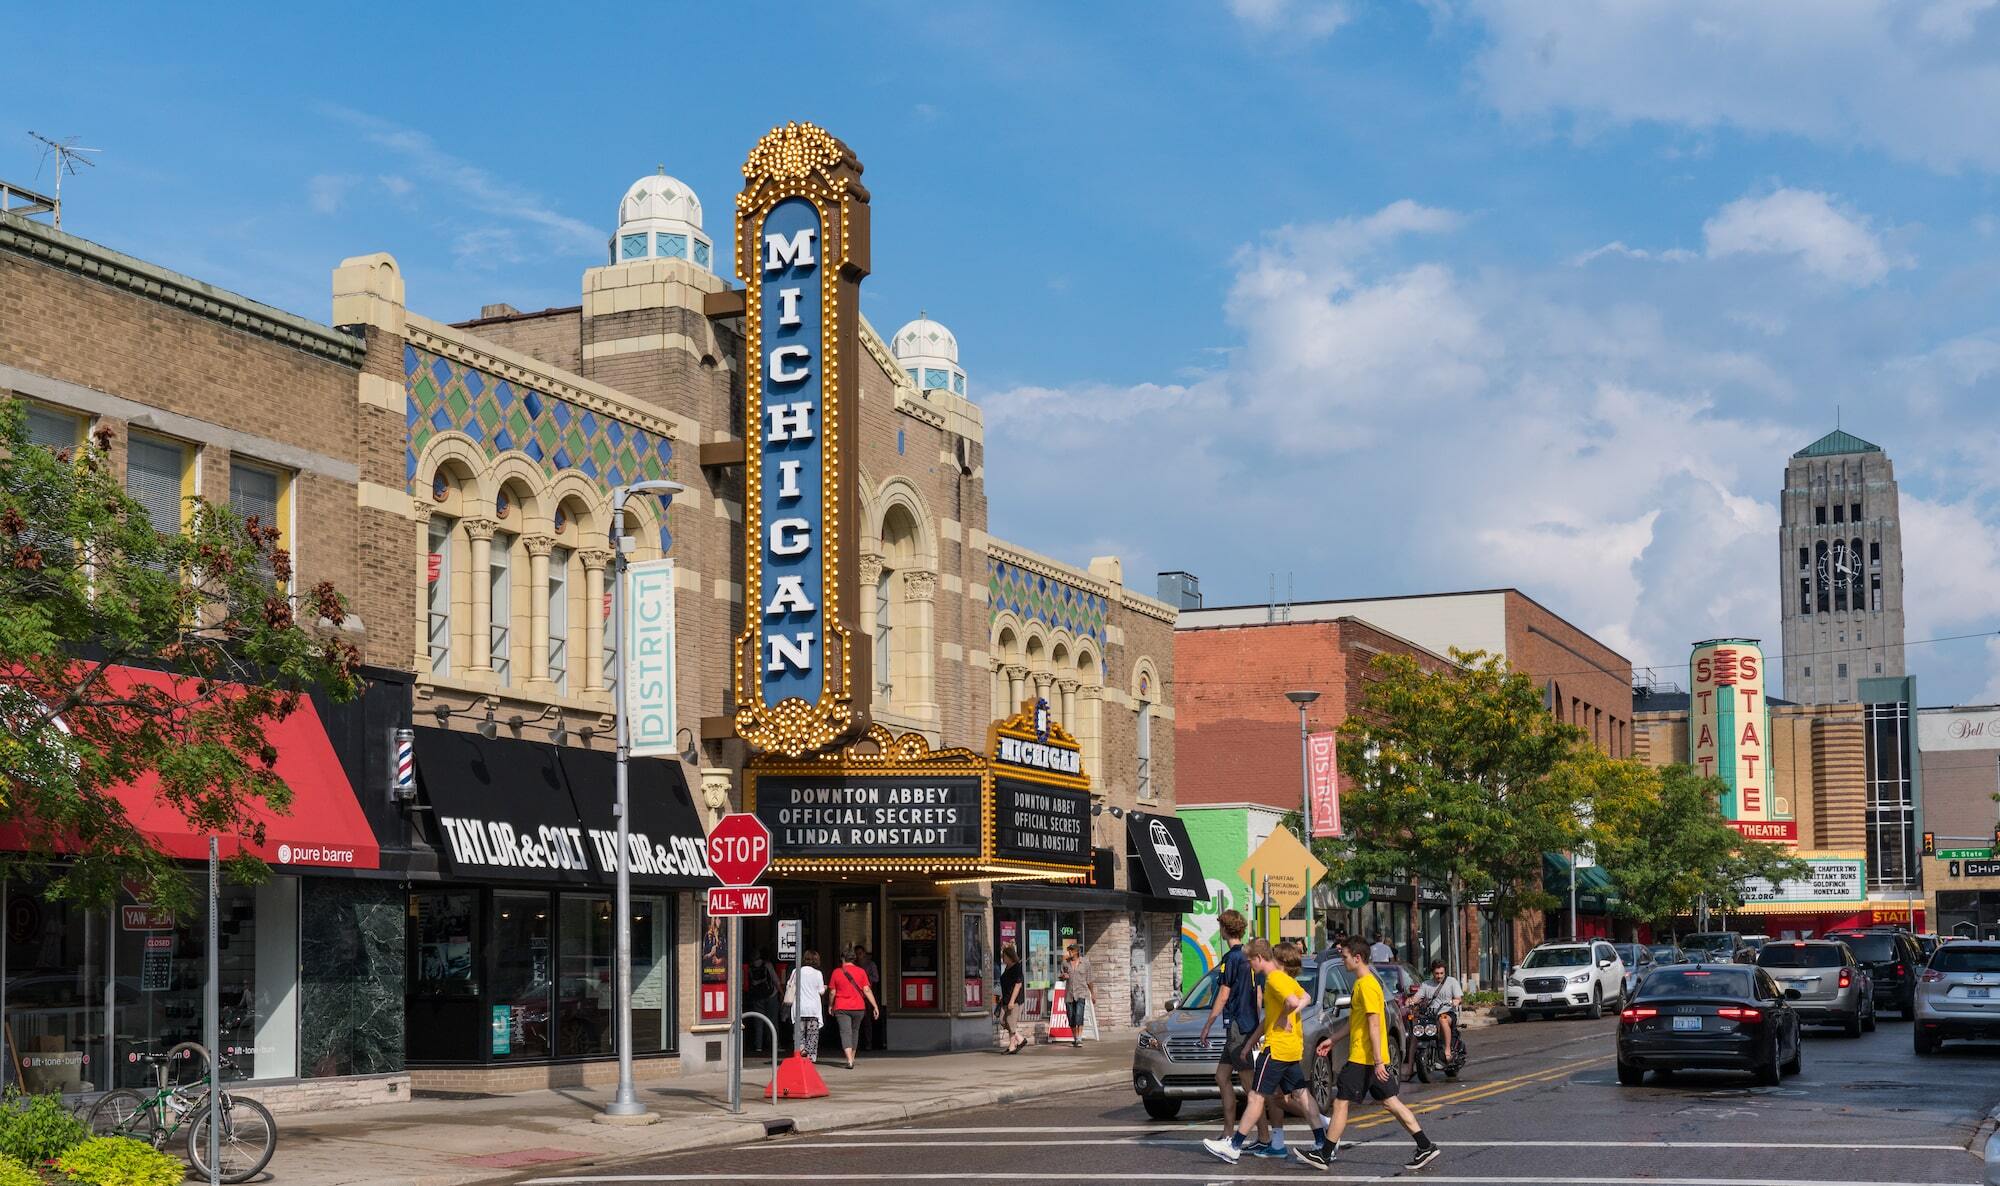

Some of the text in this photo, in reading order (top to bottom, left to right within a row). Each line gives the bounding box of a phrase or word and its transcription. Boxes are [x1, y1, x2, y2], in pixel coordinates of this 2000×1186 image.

[764, 228, 815, 671] MICHIGAN
[639, 580, 664, 737] DISTRICT
[1739, 656, 1761, 812] STATE
[1948, 718, 1984, 739] Bell
[1001, 737, 1081, 774] MICHIGAN
[1314, 743, 1333, 827] DISTRICT
[791, 788, 950, 804] DOWNTON ABBEY
[1014, 791, 1076, 815] DOWNTON ABBEY
[778, 808, 957, 825] OFFICIAL SECRETS
[1014, 811, 1080, 834] OFFICIAL SECRETS
[786, 828, 948, 845] LINDA RONSTADT
[1742, 824, 1787, 837] THEATRE
[711, 836, 766, 863] STOP
[1017, 831, 1079, 853] LINDA RONSTADT
[293, 847, 320, 863] pure
[322, 846, 353, 863] barre
[742, 892, 767, 910] WAY
[1345, 890, 1364, 902] UP
[1061, 927, 1074, 935] OPEN
[147, 939, 170, 947] CLOSED
